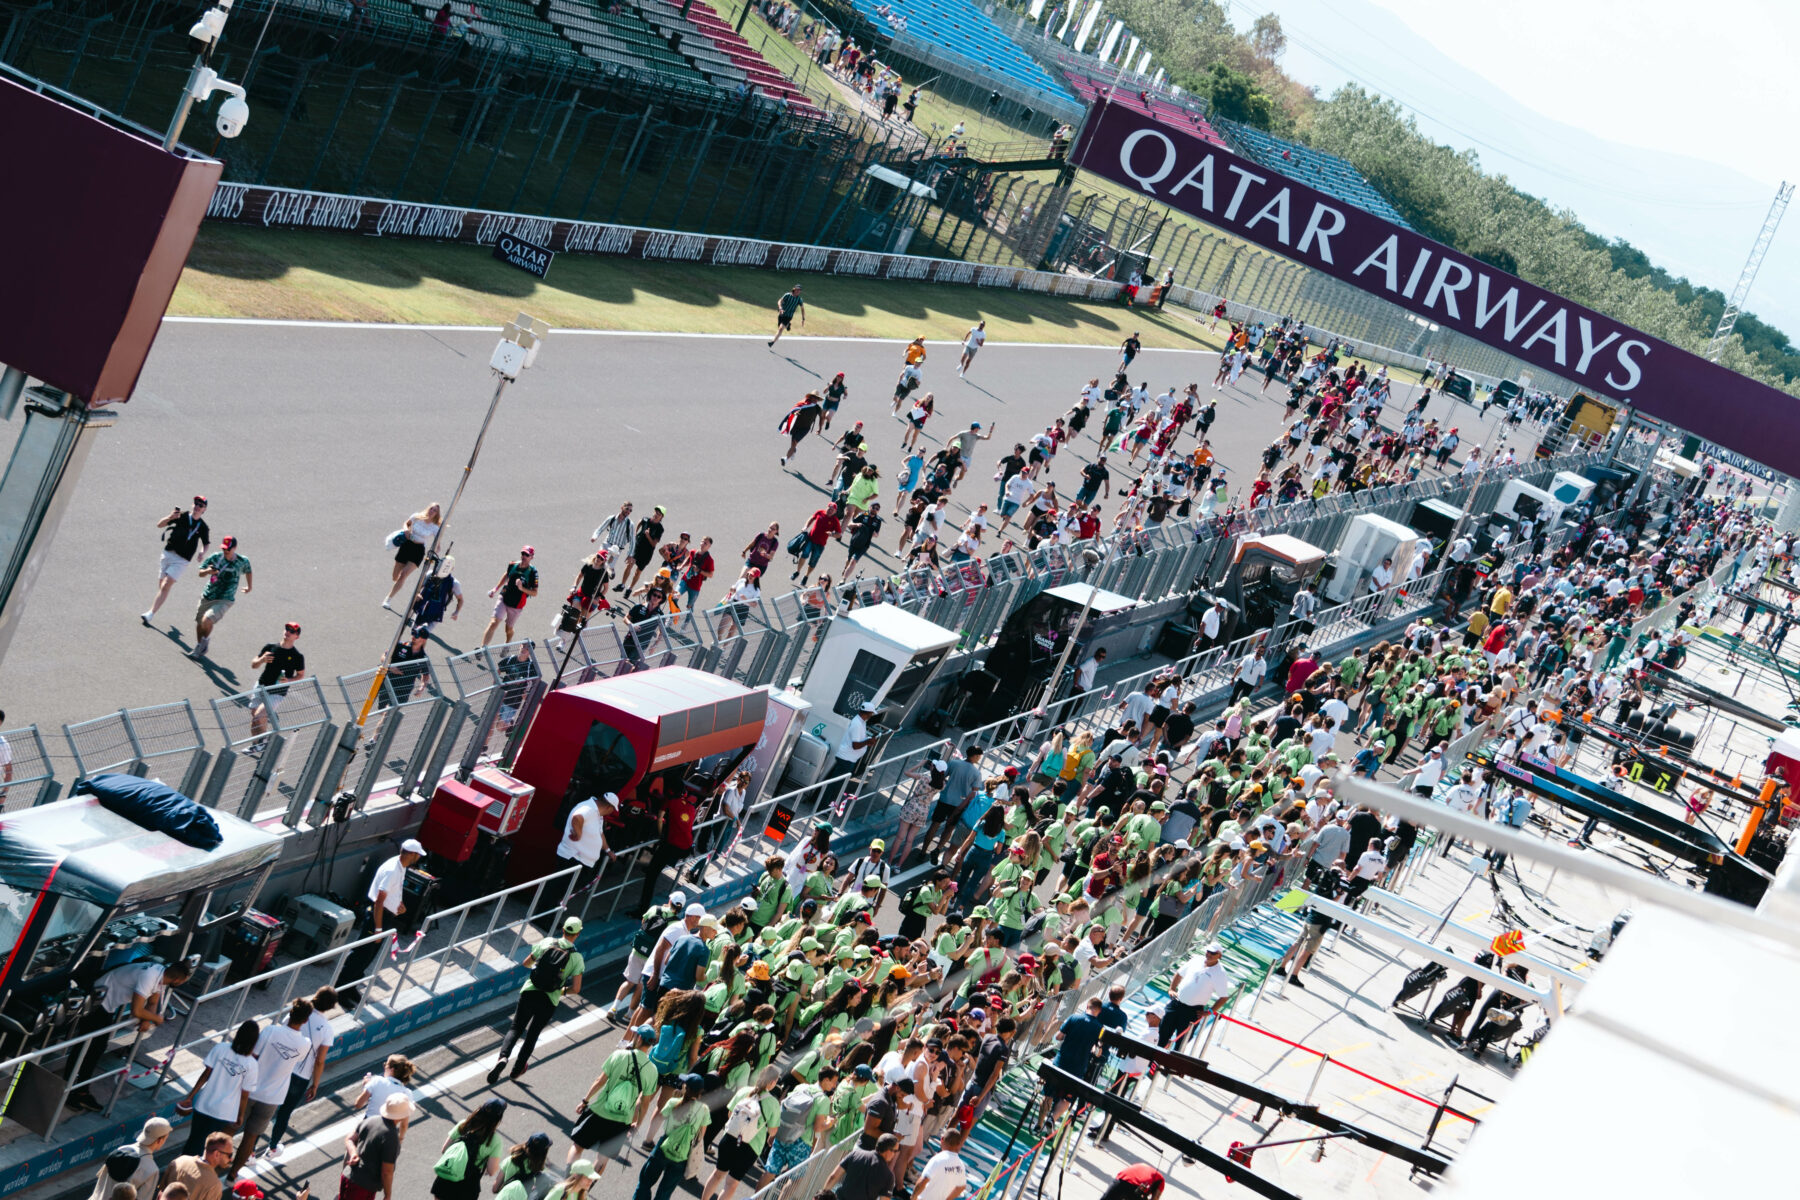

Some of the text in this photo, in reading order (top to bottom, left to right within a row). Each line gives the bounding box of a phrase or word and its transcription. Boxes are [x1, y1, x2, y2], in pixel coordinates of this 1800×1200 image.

[206, 186, 249, 219] WAYS
[263, 191, 367, 230] QATAR AIRWAYS
[376, 203, 468, 239] QATAR AIRWAYS
[476, 214, 557, 247] QATAR AIRWAYS
[500, 238, 548, 267] QATAR
[564, 223, 637, 254] QATAR AIRWAYS
[642, 232, 708, 261] QATAR AIRWAYS
[506, 253, 544, 275] AIRWAYS
[1119, 128, 1651, 392] QATAR AIRWAYS
[1508, 767, 1525, 777] BWT
[1532, 758, 1548, 768] BWT
[1406, 970, 1424, 984] IWC
[1445, 986, 1463, 1001] IWC
